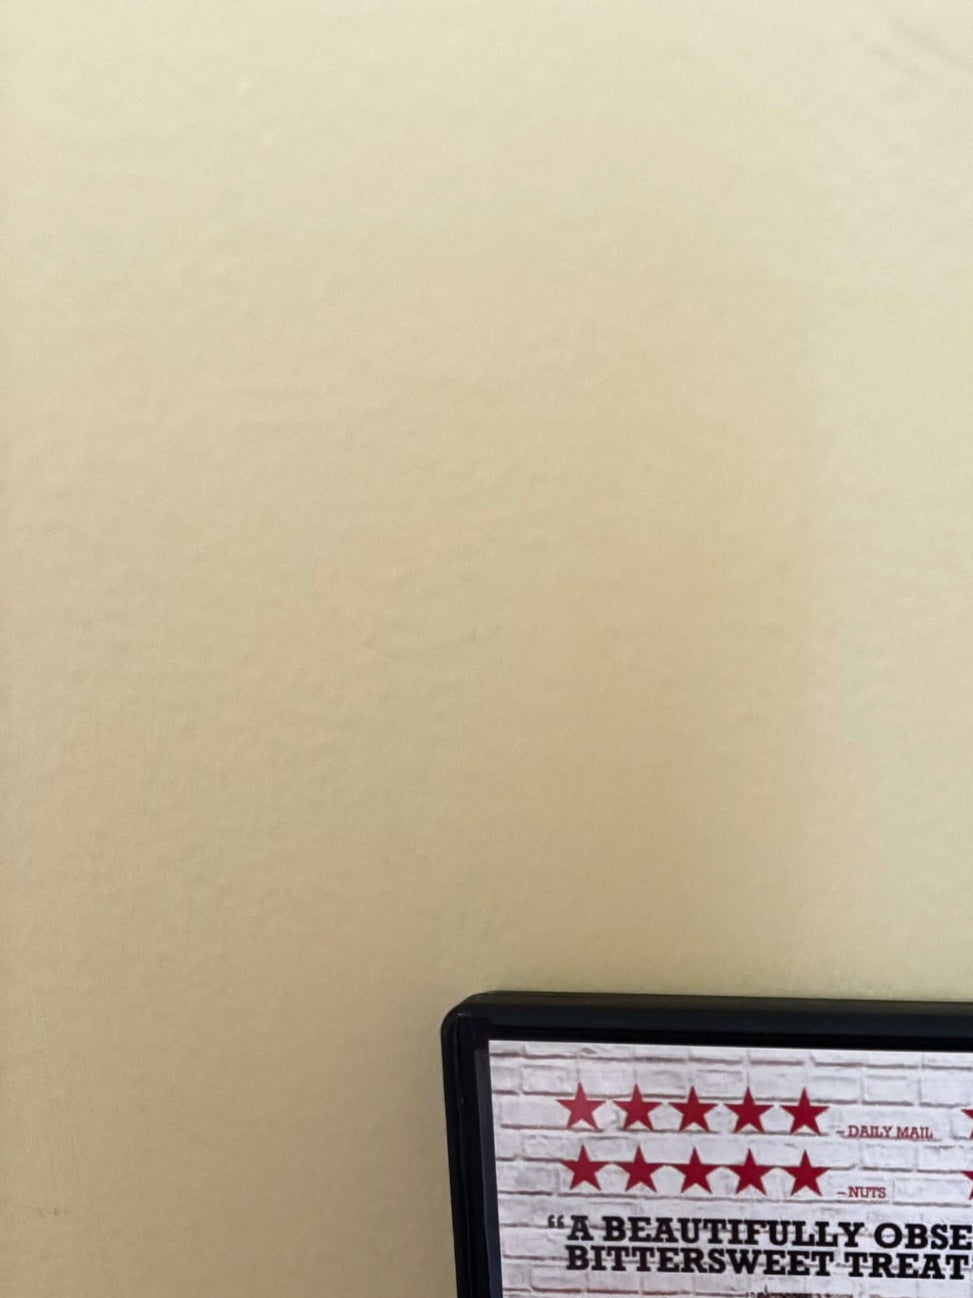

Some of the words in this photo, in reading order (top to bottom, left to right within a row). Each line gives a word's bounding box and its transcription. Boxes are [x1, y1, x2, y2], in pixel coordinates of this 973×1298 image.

[848, 1125, 893, 1139] DAILY
[897, 1126, 933, 1139] MAIL
[848, 1186, 886, 1198] NUTS
[548, 1215, 591, 1242] “A
[603, 1217, 865, 1247] BEAUTIFULLY
[566, 1247, 834, 1277] BITTERSWEET
